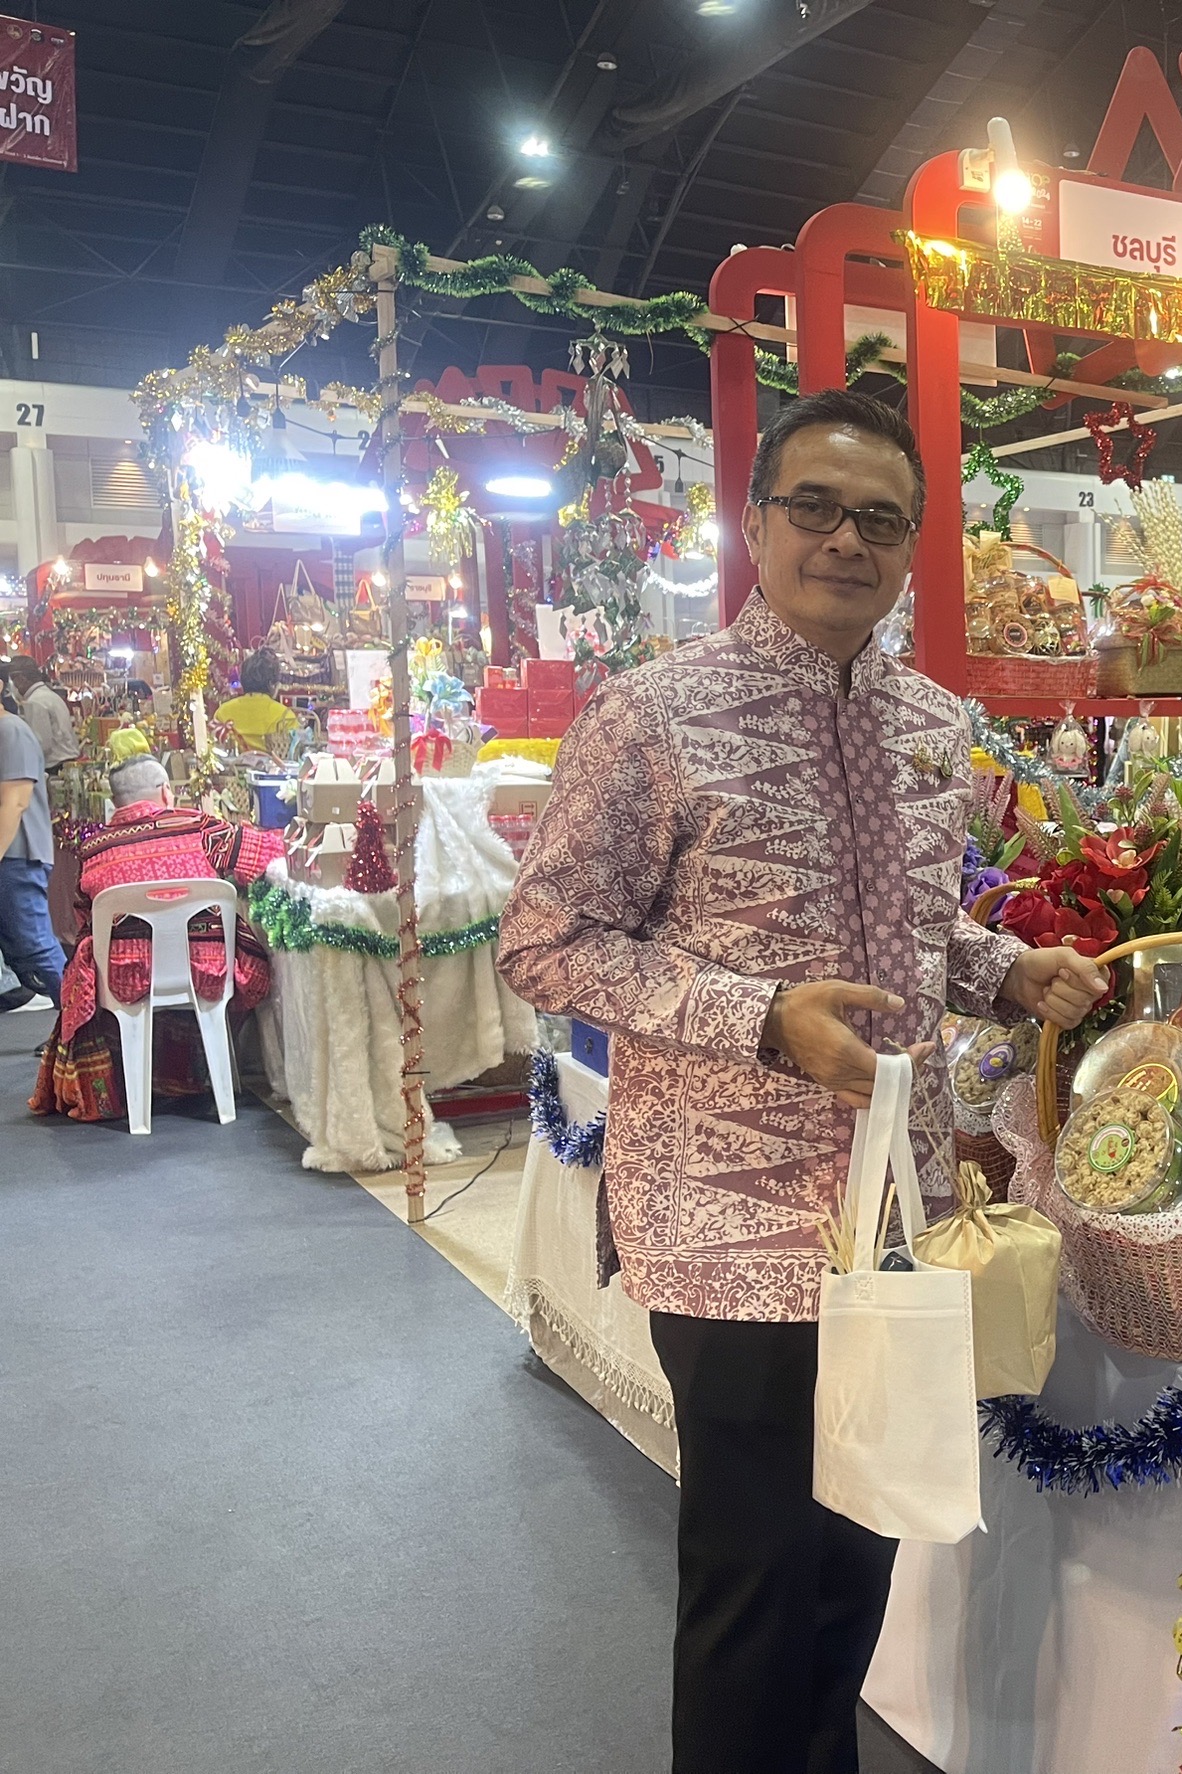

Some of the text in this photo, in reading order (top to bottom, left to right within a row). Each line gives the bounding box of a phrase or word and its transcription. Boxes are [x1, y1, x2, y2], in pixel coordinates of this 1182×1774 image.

[1112, 234, 1177, 273] ชลบุรี
[16, 403, 45, 427] 27
[357, 429, 371, 451] 2
[1078, 491, 1094, 507] 23
